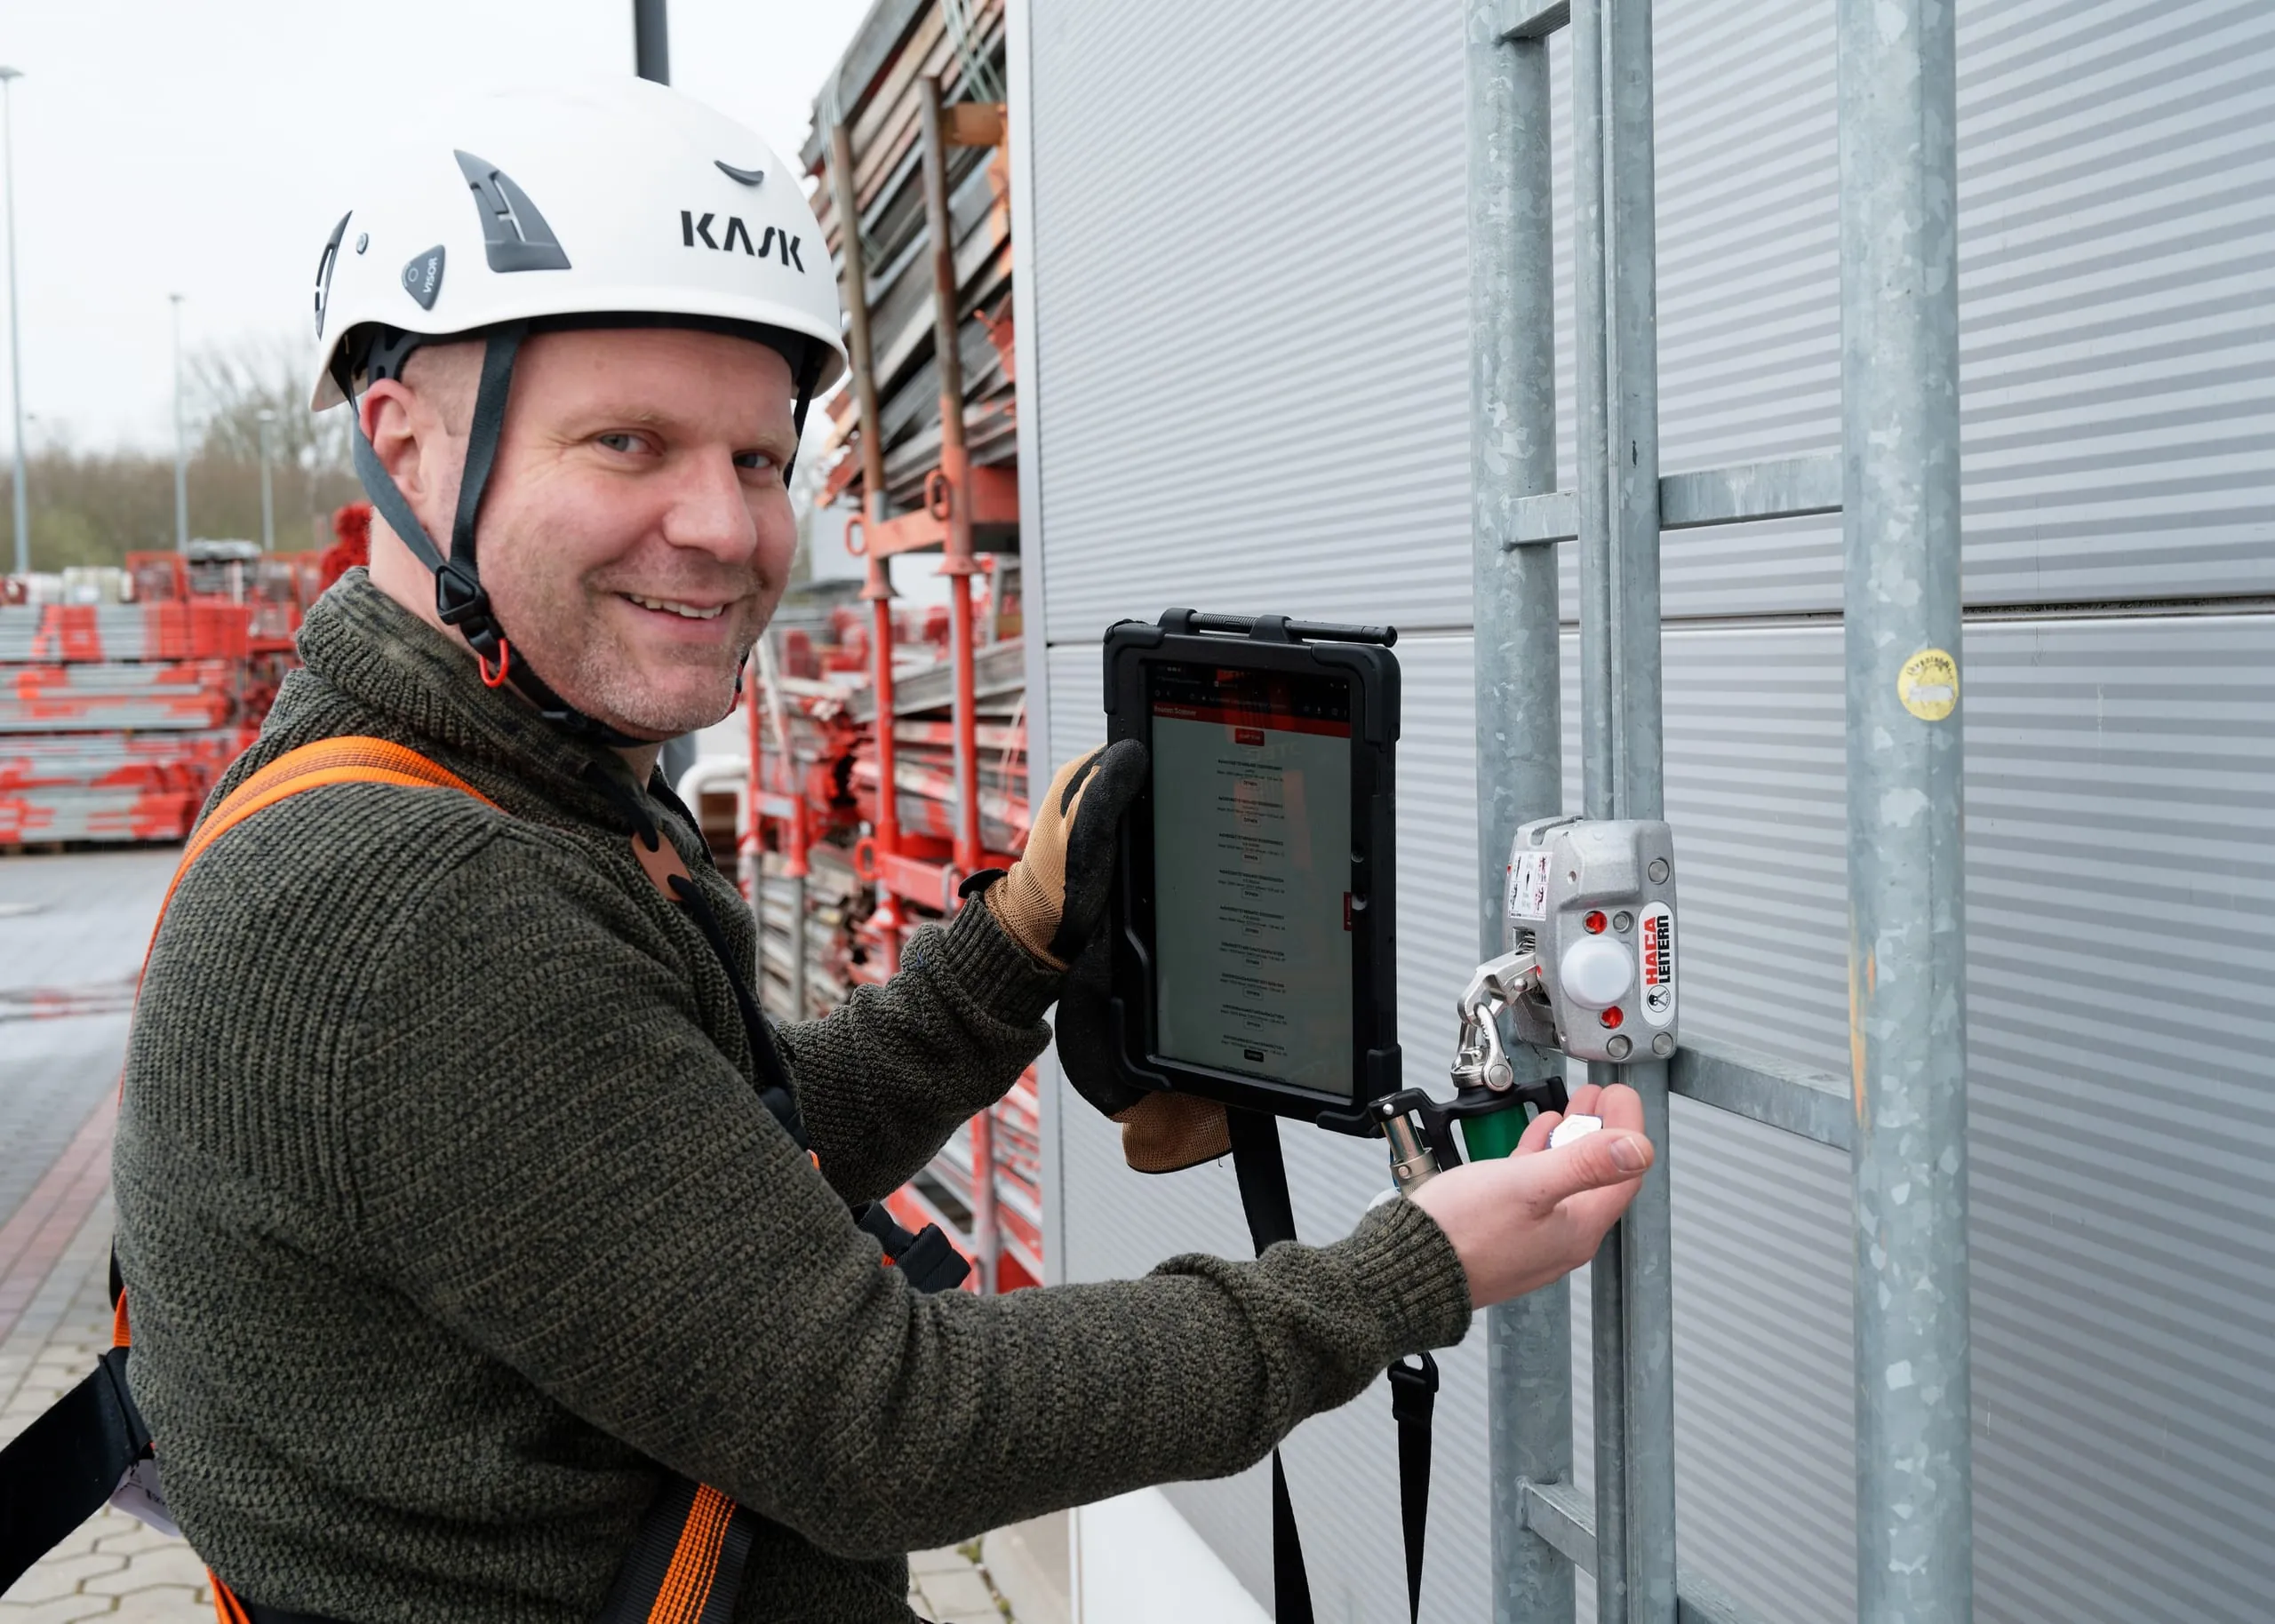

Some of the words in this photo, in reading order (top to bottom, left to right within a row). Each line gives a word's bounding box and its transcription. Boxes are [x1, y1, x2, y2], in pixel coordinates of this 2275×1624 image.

[423, 257, 438, 293] VISOR
[681, 210, 805, 274] KASK
[1644, 916, 1658, 985] HACA
[1656, 915, 1671, 984] LEITERN
